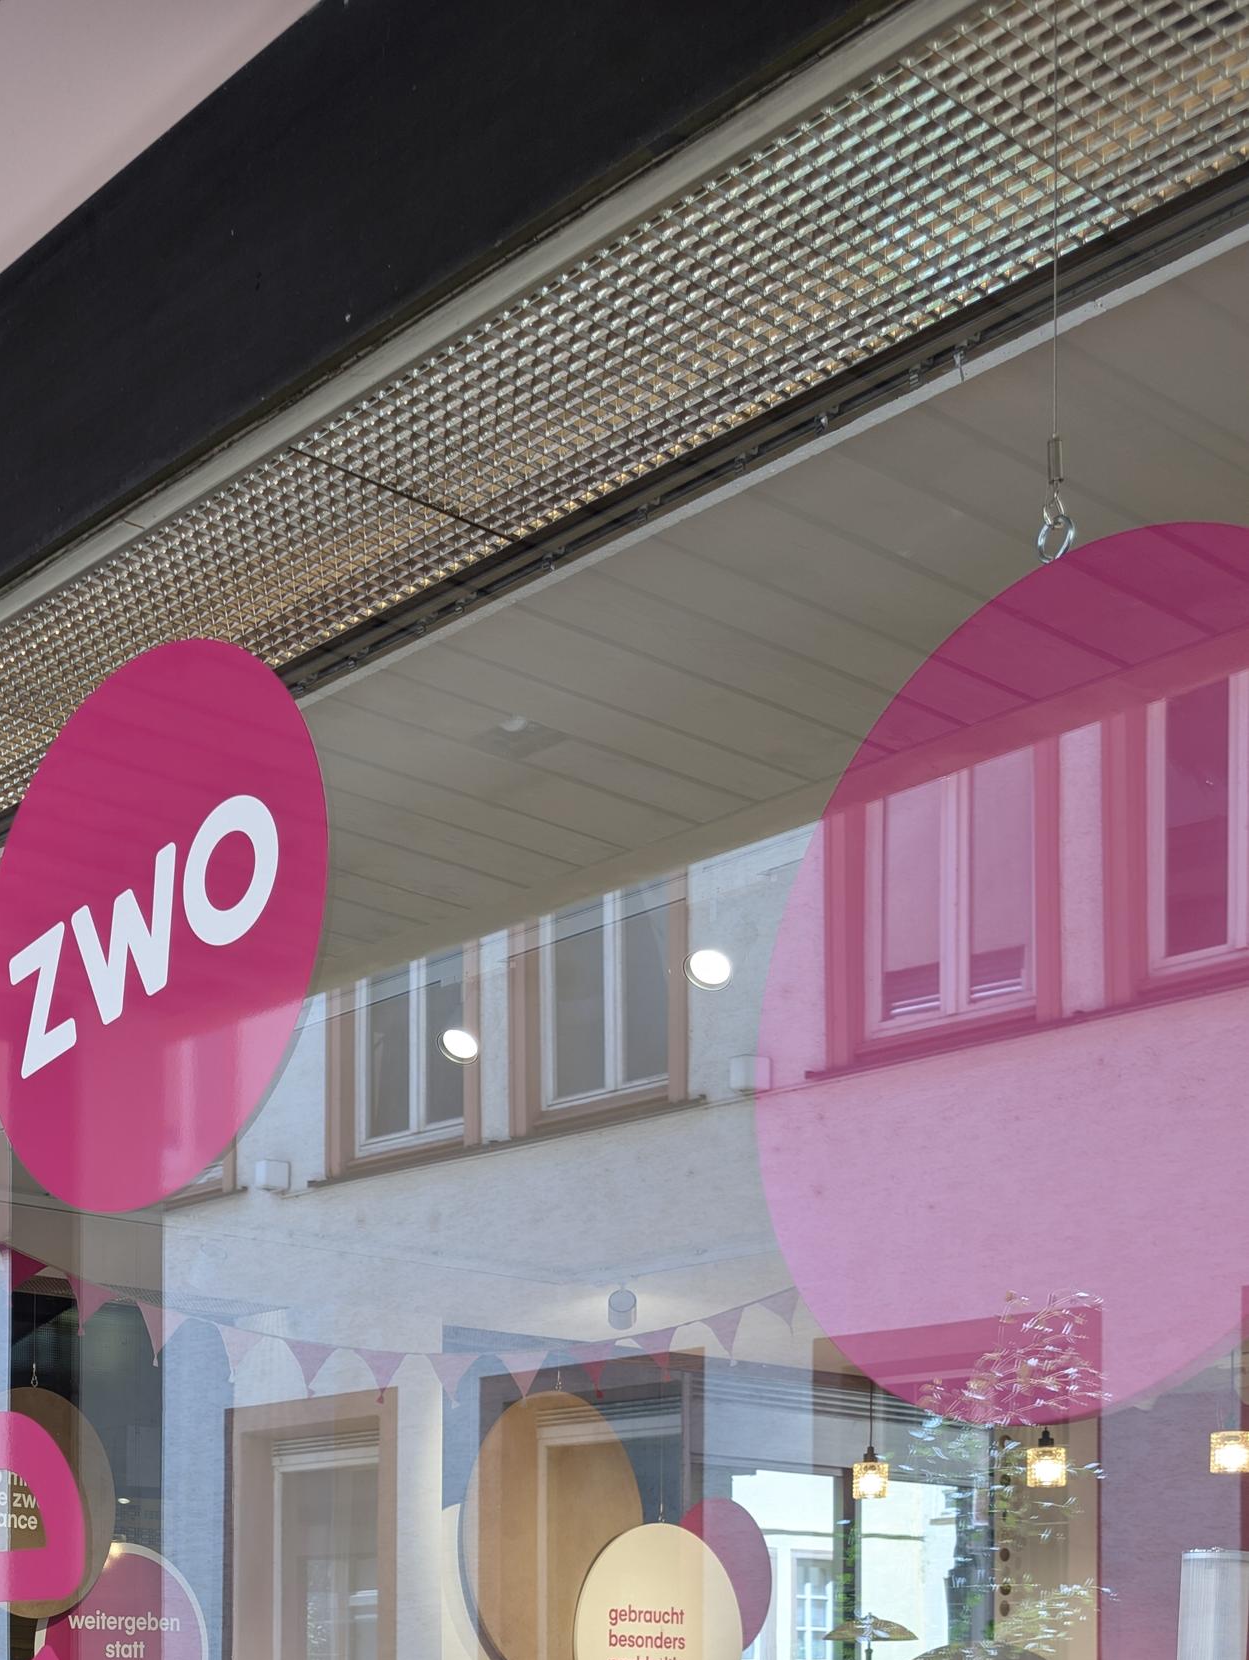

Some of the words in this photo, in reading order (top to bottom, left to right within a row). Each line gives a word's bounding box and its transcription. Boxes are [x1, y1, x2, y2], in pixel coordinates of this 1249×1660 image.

[68, 1609, 181, 1635] weitergeben
[608, 1604, 685, 1626] gebraucht
[105, 1641, 145, 1658] statt
[608, 1629, 686, 1650] besonders
